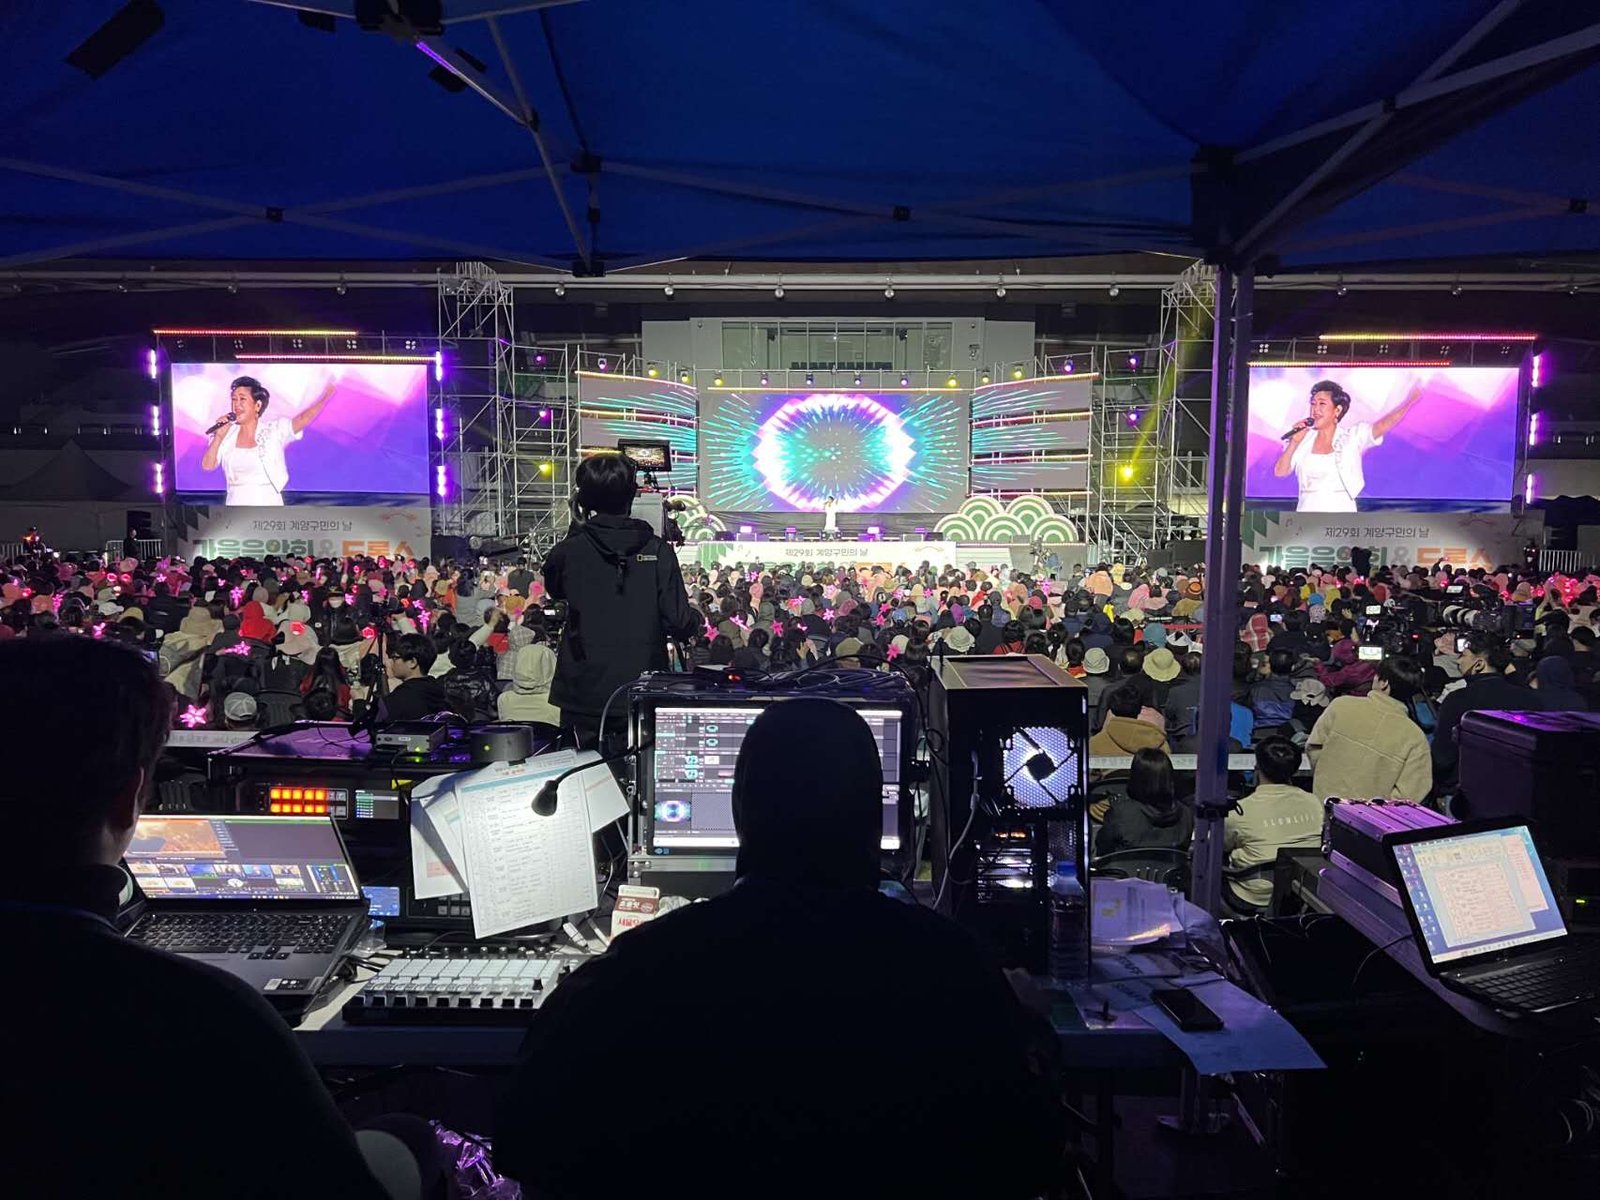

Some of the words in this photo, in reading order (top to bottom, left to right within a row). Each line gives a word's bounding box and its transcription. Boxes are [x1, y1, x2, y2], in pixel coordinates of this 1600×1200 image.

[253, 520, 286, 532] 제29회
[290, 520, 340, 532] 계양구민의
[342, 520, 353, 532] 날
[1325, 526, 1360, 538] 제29회
[1363, 526, 1416, 538] 계양구민의
[1418, 527, 1430, 538] 날
[785, 548, 813, 557] 제29회
[816, 548, 858, 557] 계양구민의
[859, 548, 869, 557] 날
